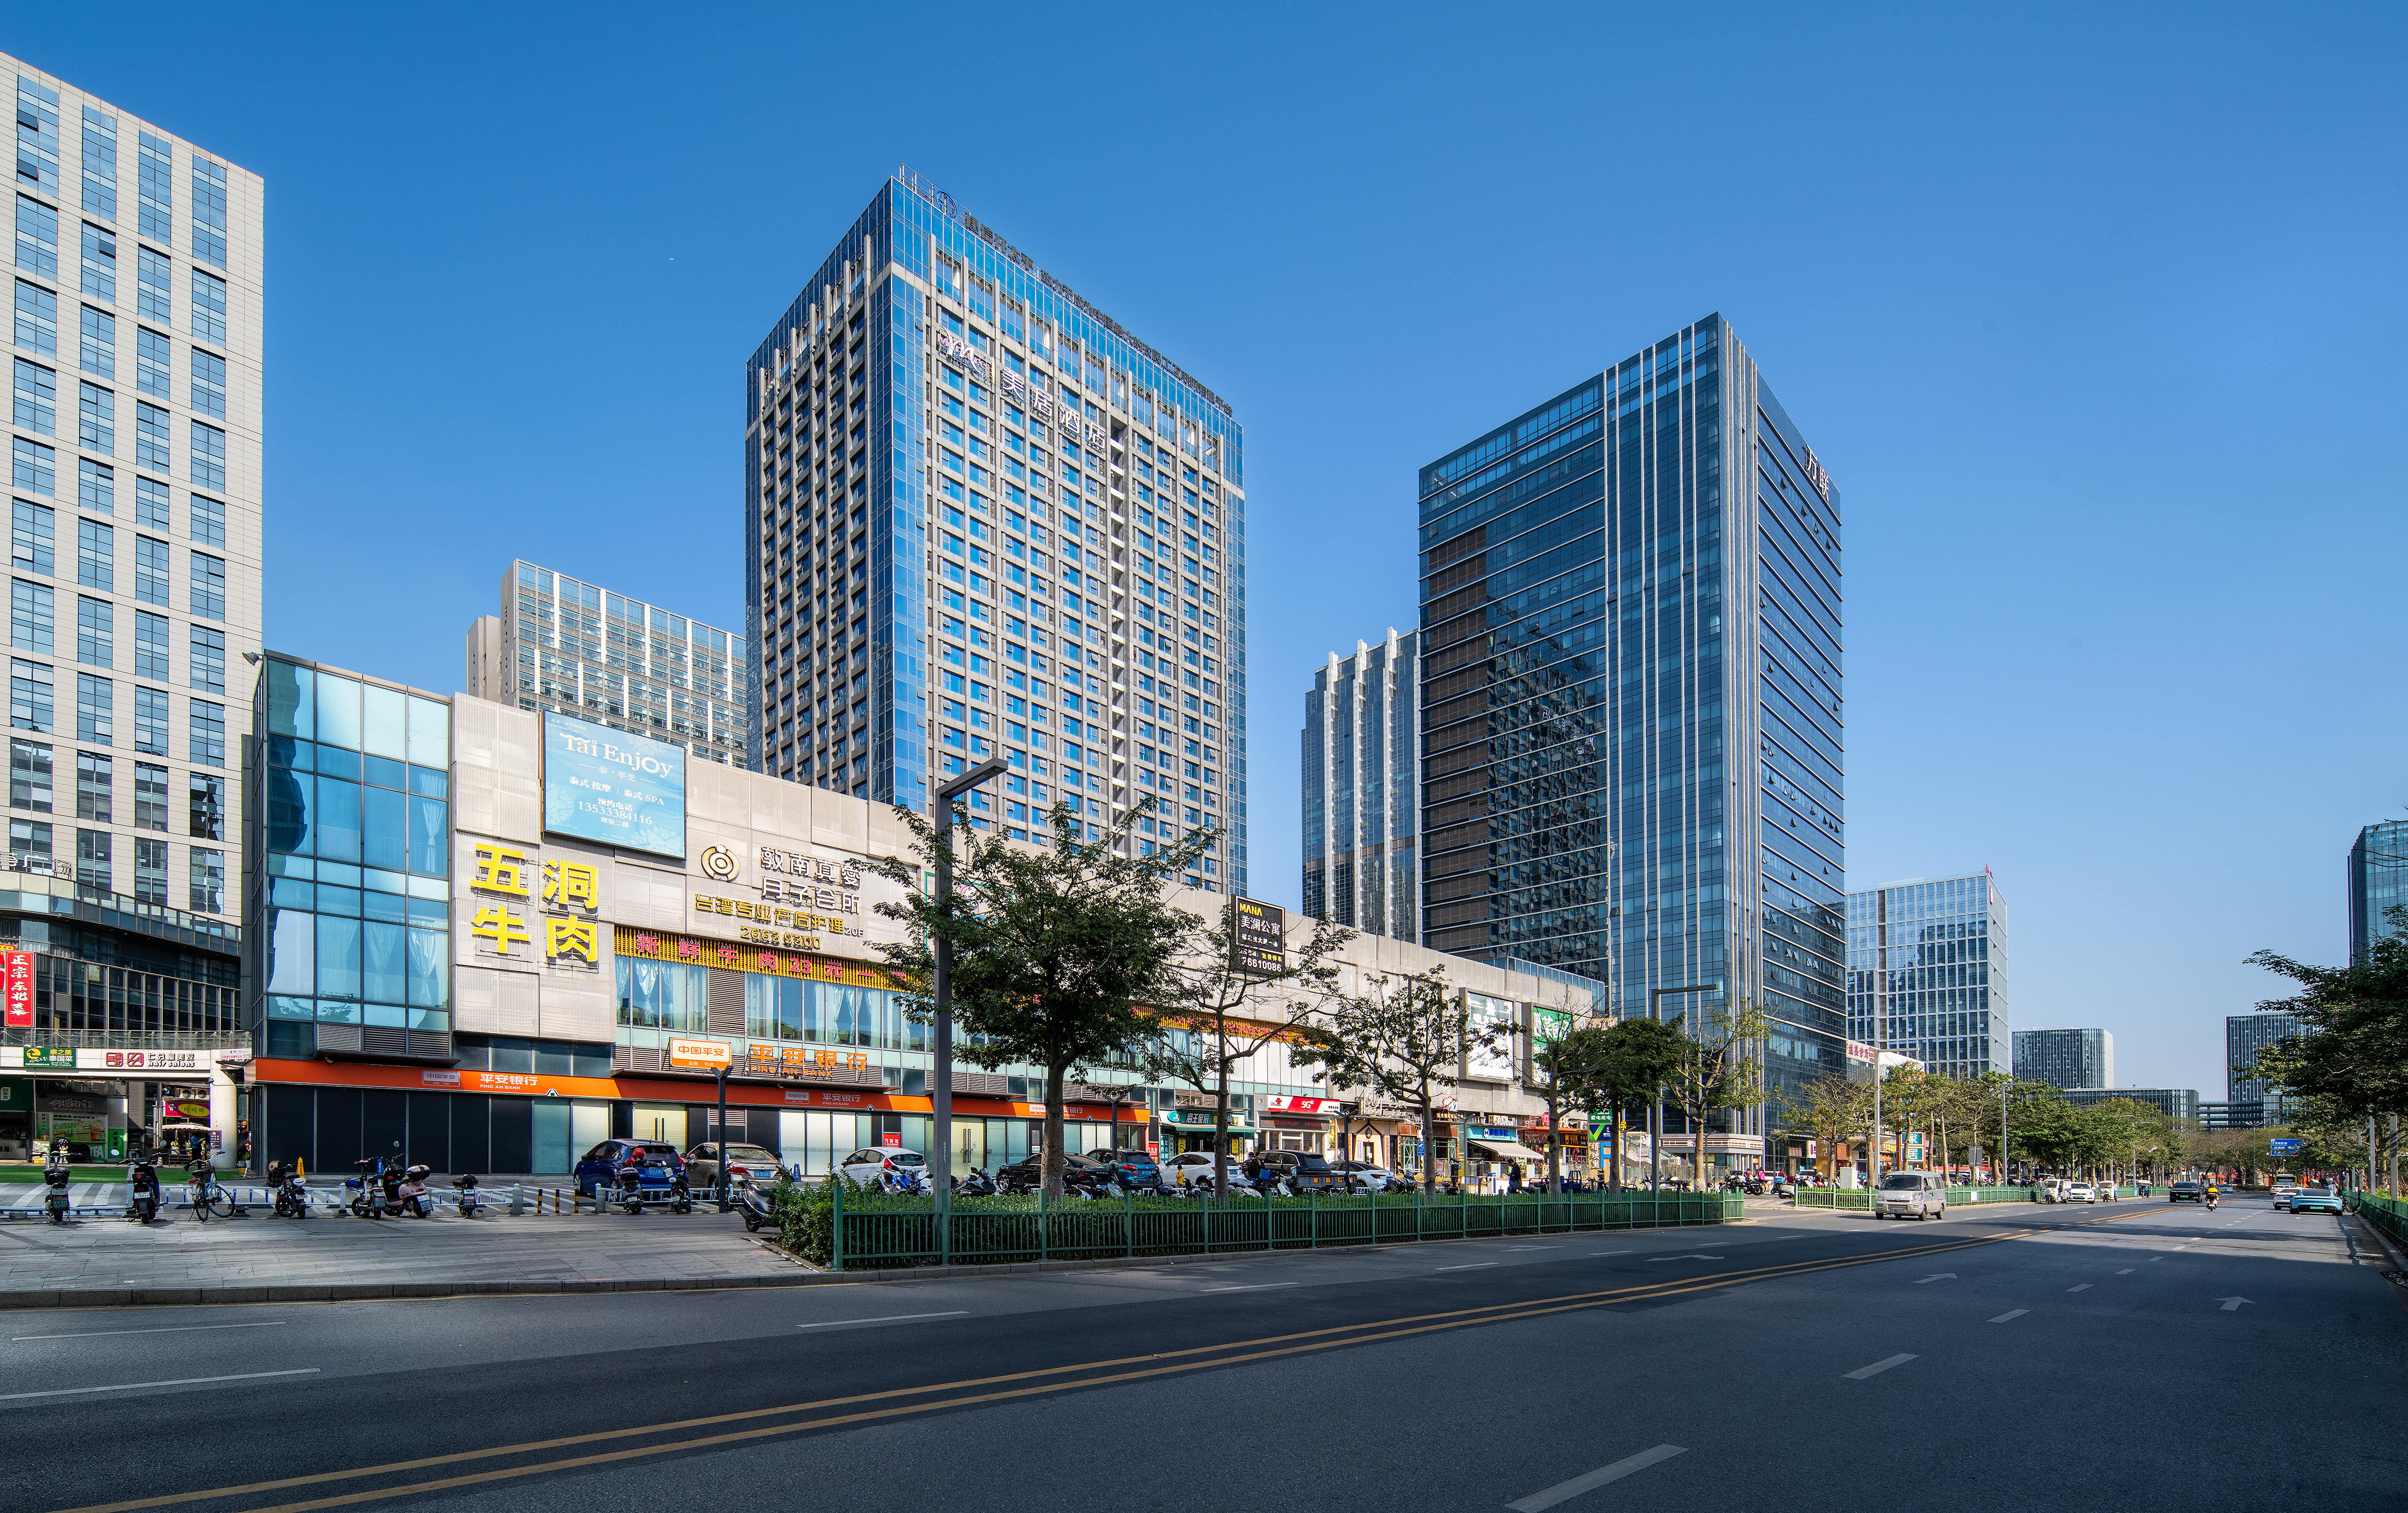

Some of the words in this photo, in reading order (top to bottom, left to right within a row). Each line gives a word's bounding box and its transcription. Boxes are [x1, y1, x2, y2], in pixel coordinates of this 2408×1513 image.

[1002, 368, 1106, 449] 美居酒店
[597, 797, 633, 812] 预约电话
[646, 794, 664, 806] SPA
[578, 801, 653, 826] 13533384116
[600, 817, 629, 829] 商场二楼
[762, 876, 861, 914] 月子会所
[1239, 903, 1263, 917] MANA
[740, 926, 780, 943] 2663
[784, 931, 821, 949] 9300
[9, 954, 30, 1016] 正宗东北菜
[678, 1045, 724, 1056] 中国平安
[750, 1044, 867, 1070] 平安银行
[750, 1065, 775, 1074] PING
[783, 1067, 798, 1076] AN
[803, 1068, 832, 1077] BANK
[479, 1073, 538, 1086] 平安银行
[822, 1093, 861, 1102] 平安银行
[1186, 1113, 1210, 1124] 海王星辰
[90, 1146, 104, 1158] TEA
